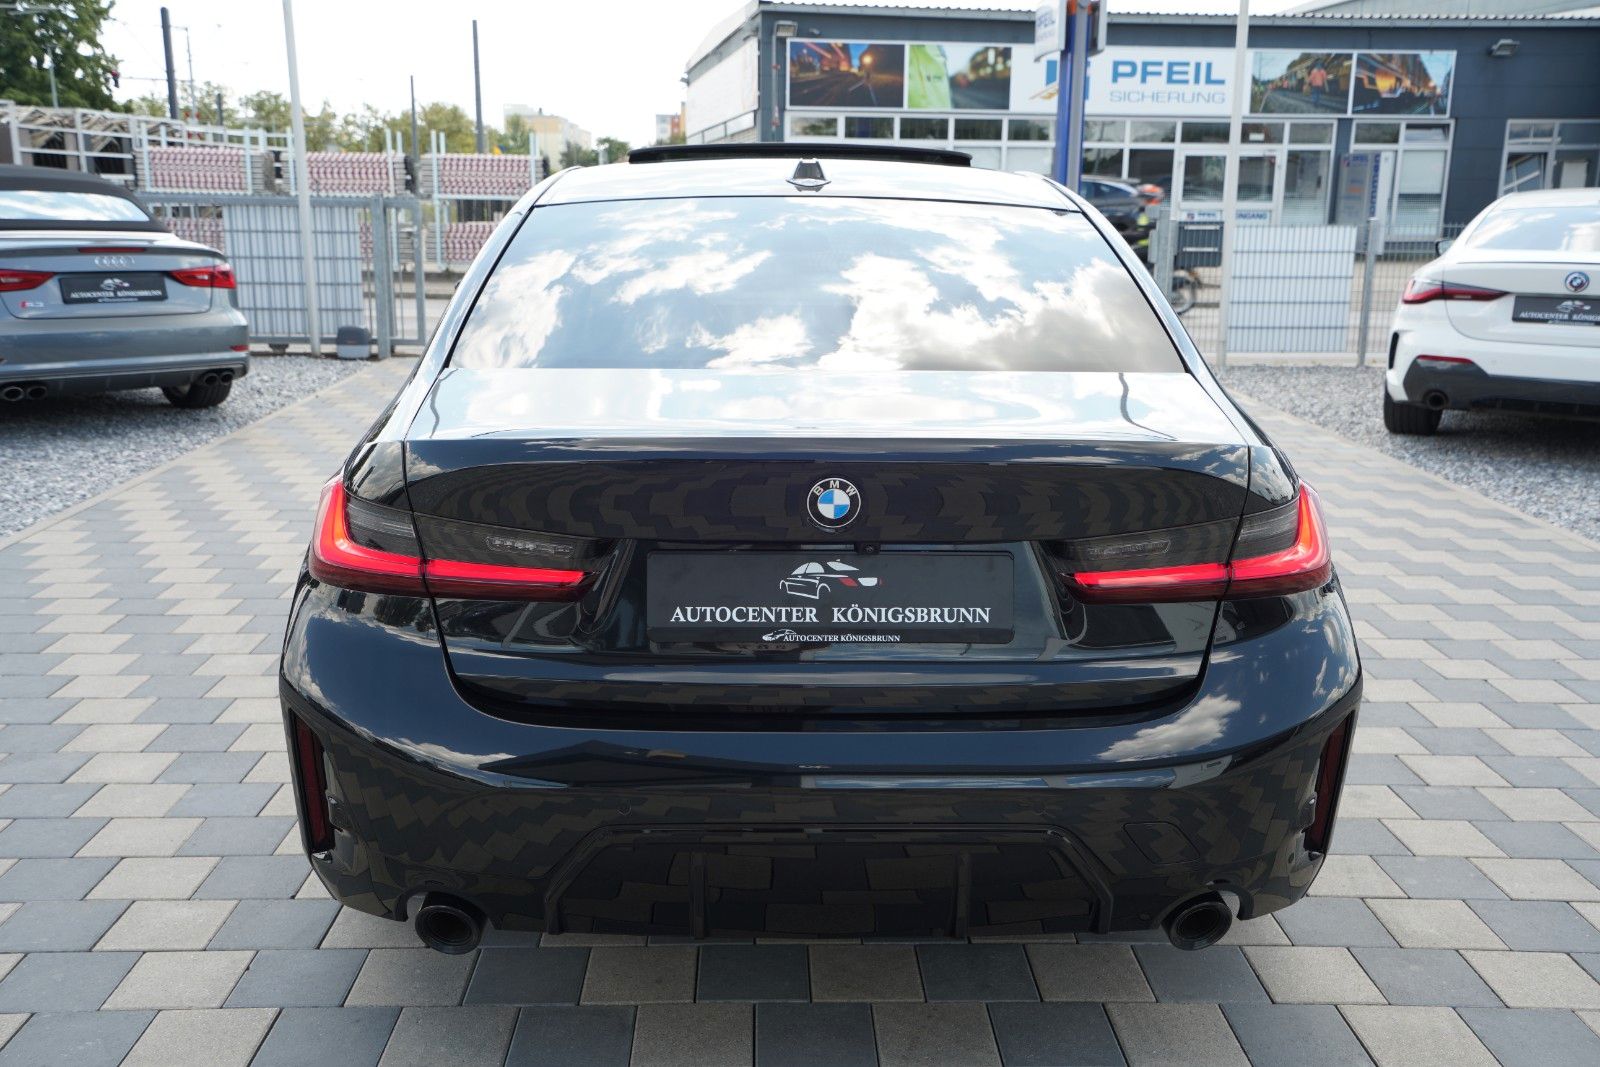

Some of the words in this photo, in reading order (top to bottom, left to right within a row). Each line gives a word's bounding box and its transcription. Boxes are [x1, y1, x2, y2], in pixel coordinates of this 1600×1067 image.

[1111, 60, 1226, 85] PFEIL
[1109, 90, 1226, 105] SICHERUNG
[813, 479, 857, 497] BMW
[670, 606, 819, 623] AUTOCENTER
[831, 603, 992, 624] KÖNIGSBRUNN
[783, 634, 839, 642] AUTOCENTER
[840, 633, 901, 642] KÖNIGSBRUNN
